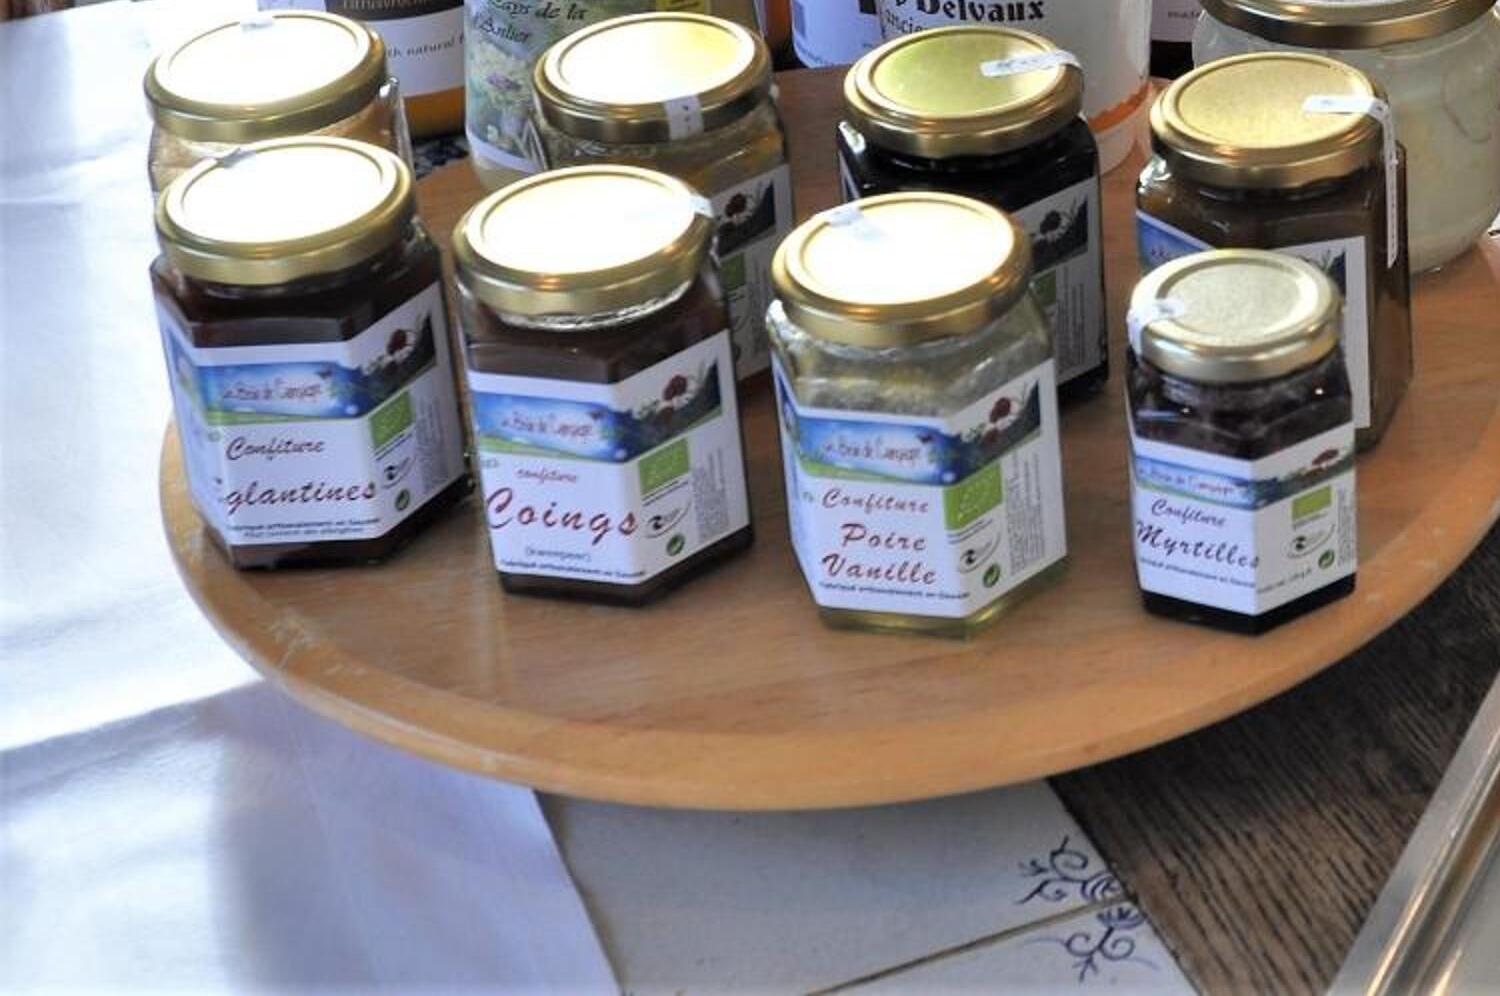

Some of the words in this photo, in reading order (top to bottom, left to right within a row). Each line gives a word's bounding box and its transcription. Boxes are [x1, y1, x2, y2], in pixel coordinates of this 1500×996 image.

[226, 436, 325, 461] Confiture
[214, 477, 378, 515] glantines
[822, 487, 930, 515] Confiture
[486, 487, 639, 547] Coings
[1151, 498, 1228, 528] Confiture
[840, 523, 928, 552] Poire
[822, 553, 937, 586] Vanille
